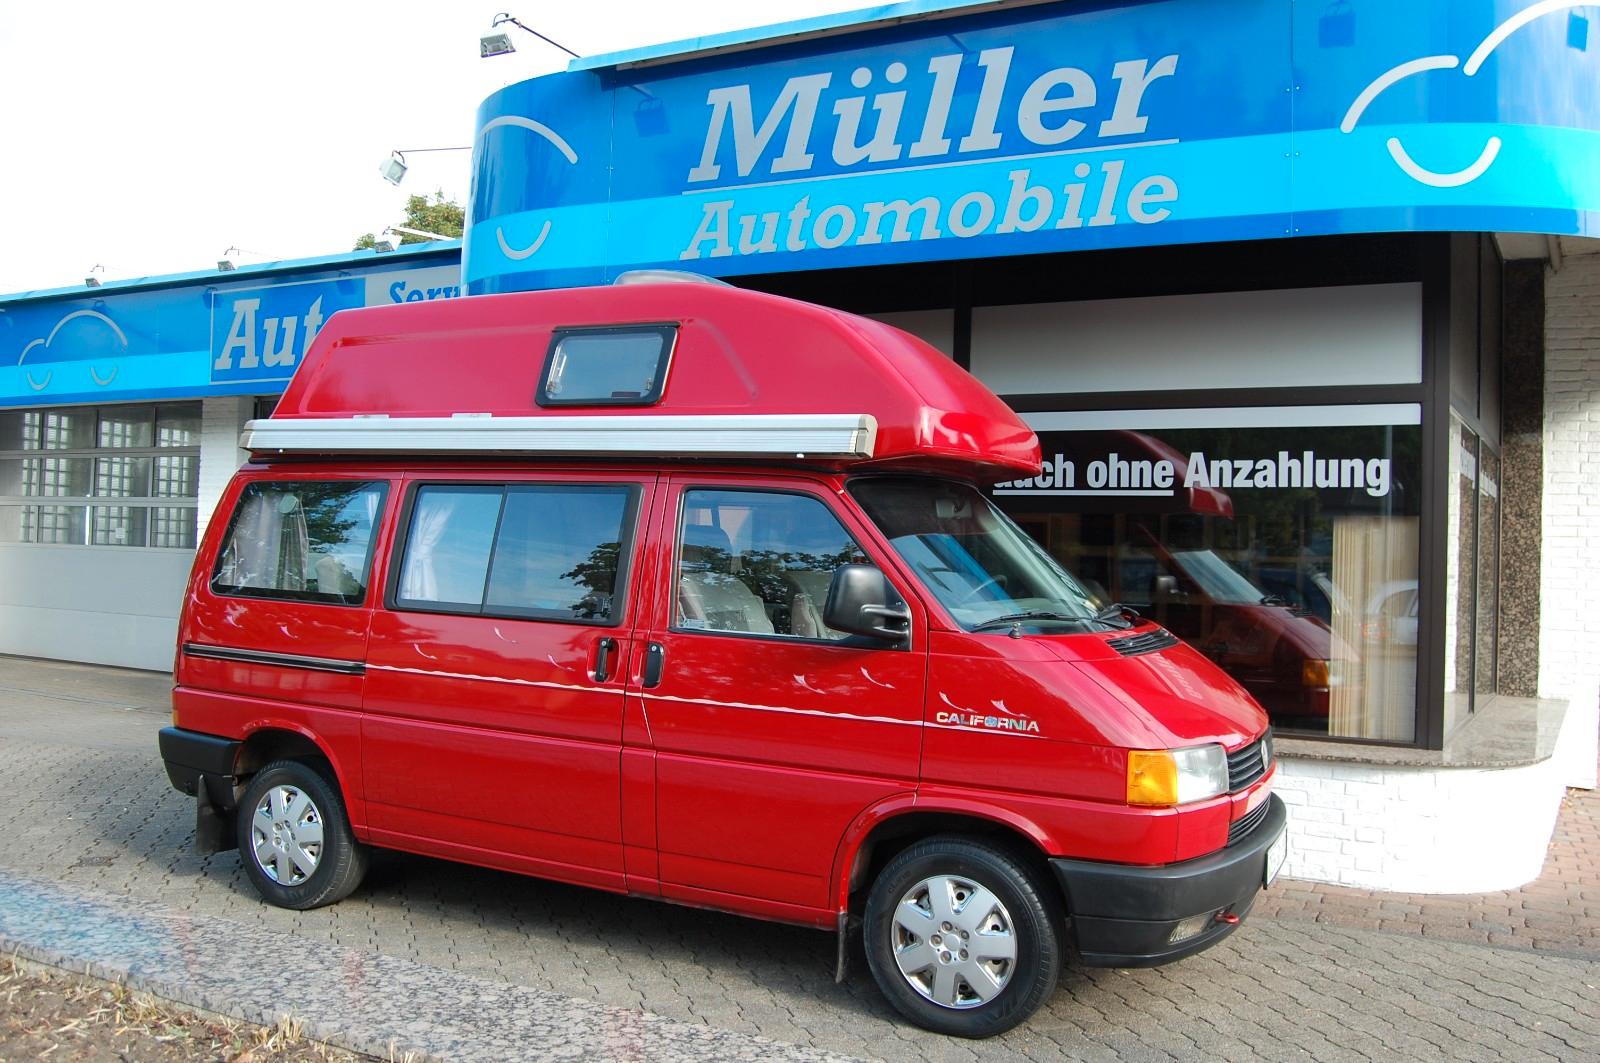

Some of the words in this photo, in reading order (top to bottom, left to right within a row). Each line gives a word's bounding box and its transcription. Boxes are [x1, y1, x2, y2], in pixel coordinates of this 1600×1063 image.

[688, 46, 1179, 183] Müller
[679, 160, 1179, 261] Automobile
[1086, 453, 1174, 488] ohne
[1184, 450, 1390, 497] Anzahlung
[936, 711, 1040, 732] CALIFORNIA
